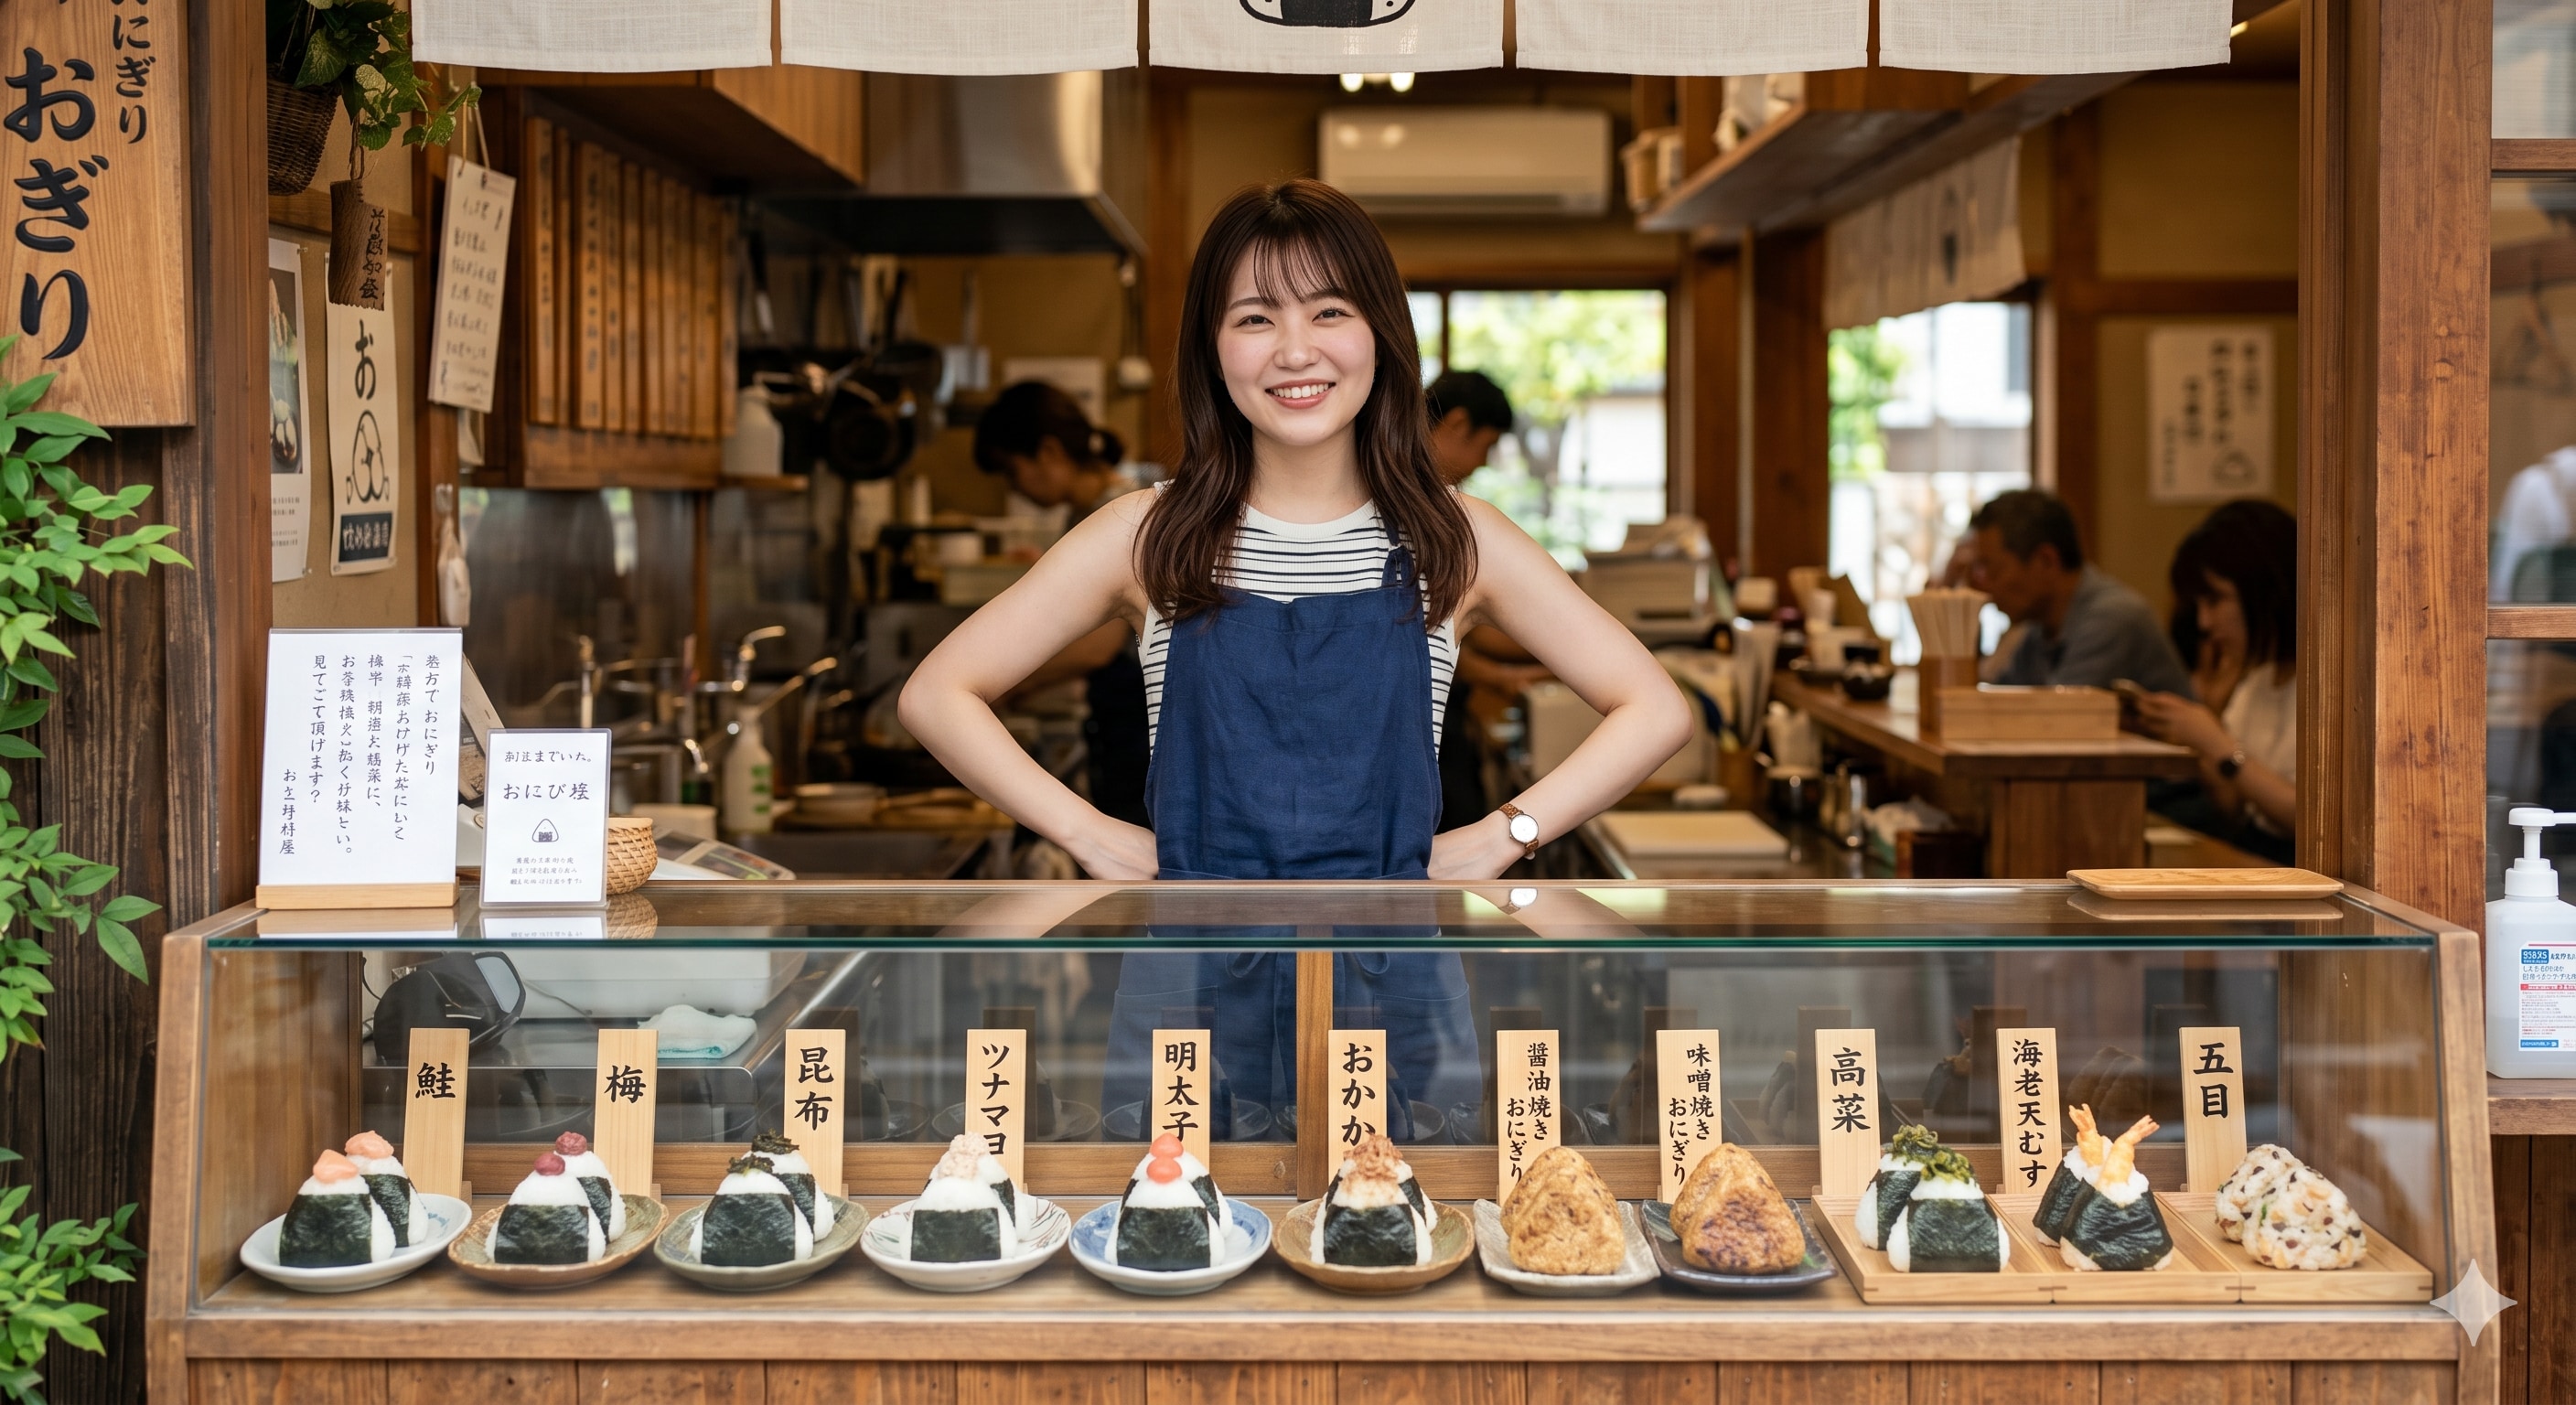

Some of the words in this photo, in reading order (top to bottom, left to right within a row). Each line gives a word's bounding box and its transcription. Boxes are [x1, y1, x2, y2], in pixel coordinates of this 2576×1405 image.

[111, 0, 156, 145] にぎり
[414, 1061, 456, 1099] 鮭
[603, 1065, 647, 1104] 梅
[793, 1046, 834, 1132] 昆布
[980, 1043, 1010, 1155] ツナマヨ
[1162, 1041, 1200, 1142] 明太子
[1341, 1042, 1376, 1147] おかか
[1830, 1046, 1872, 1133] 高菜
[2012, 1038, 2048, 1189] 海老天むす
[2193, 1041, 2235, 1120] 五目
[1506, 1097, 1528, 1185] おにぎり
[1669, 1097, 1690, 1186] おにぎり
